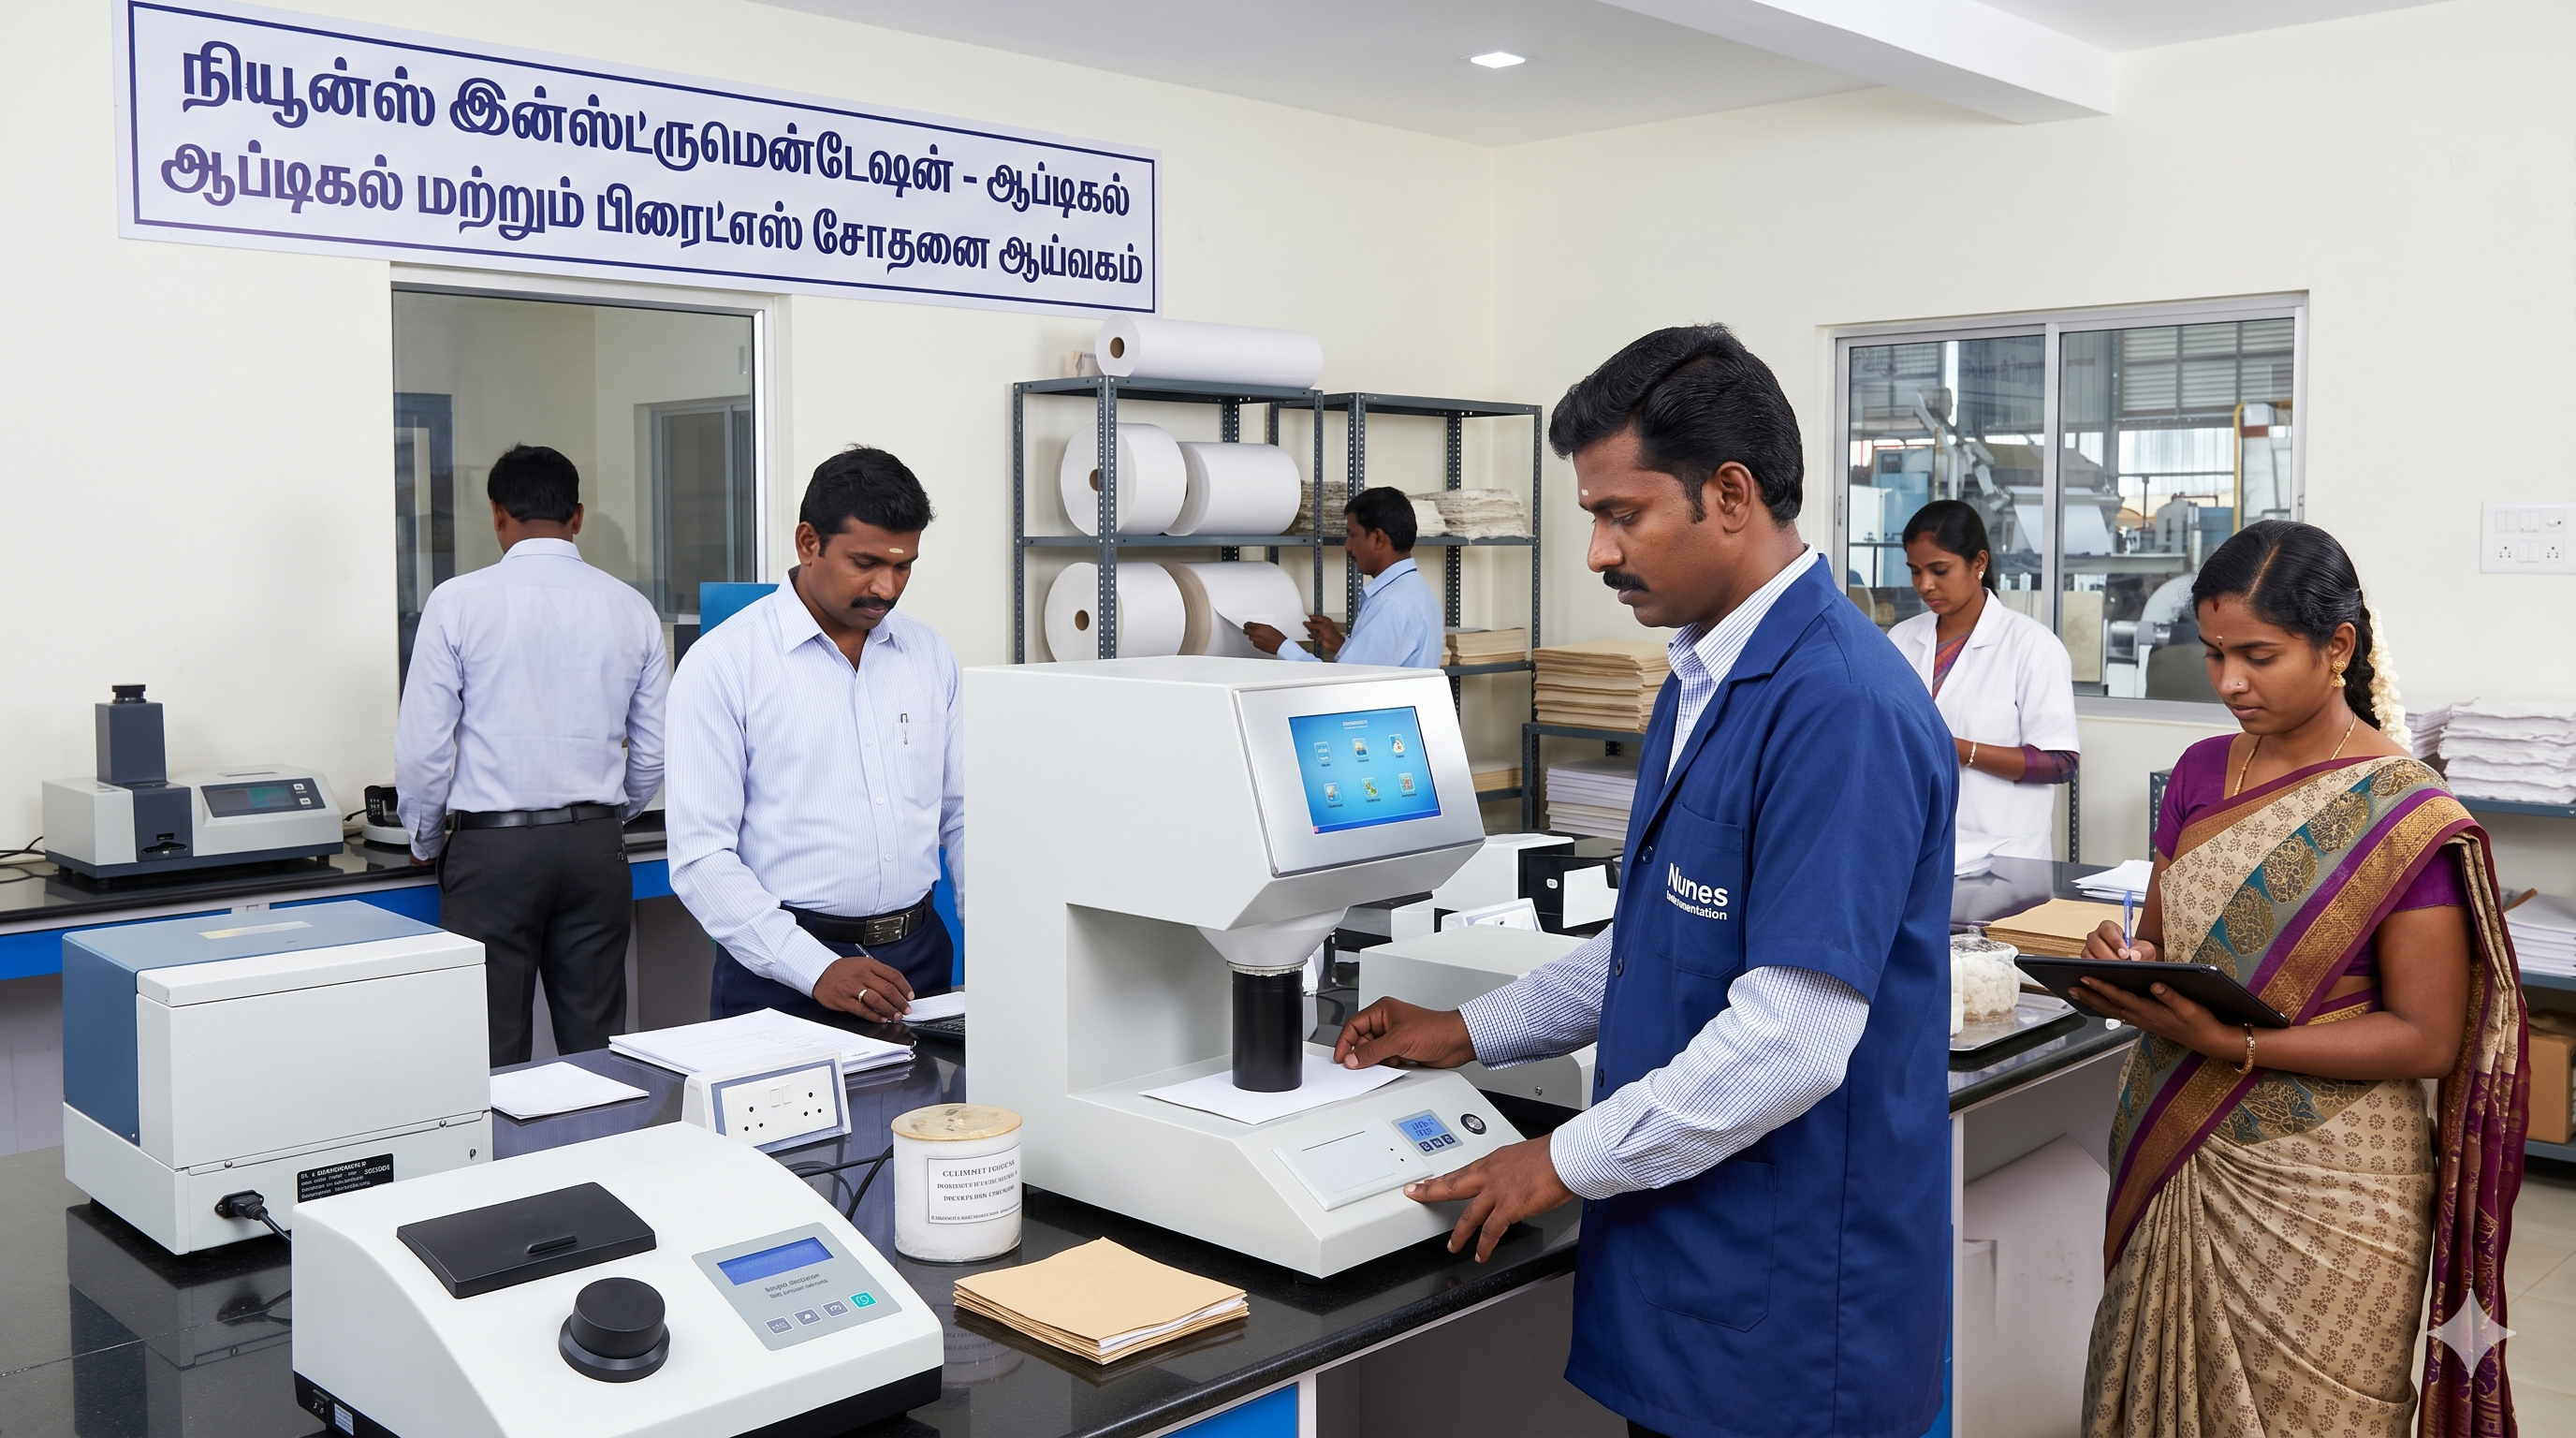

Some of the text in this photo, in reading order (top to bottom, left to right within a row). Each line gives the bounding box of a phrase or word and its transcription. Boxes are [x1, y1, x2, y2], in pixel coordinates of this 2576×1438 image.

[182, 40, 436, 129] நியூன்ஸ்
[448, 77, 955, 198] இன்ஸ்ட்ருமென்டேஷன்
[986, 161, 1130, 219] ஆப்டிகல்
[160, 139, 403, 214] ஆப்டிகல்
[417, 165, 585, 242] மற்றும்
[812, 208, 990, 275] சோதனை
[998, 233, 1143, 285] ஆய்வகம்
[1667, 861, 1729, 907] Nunes
